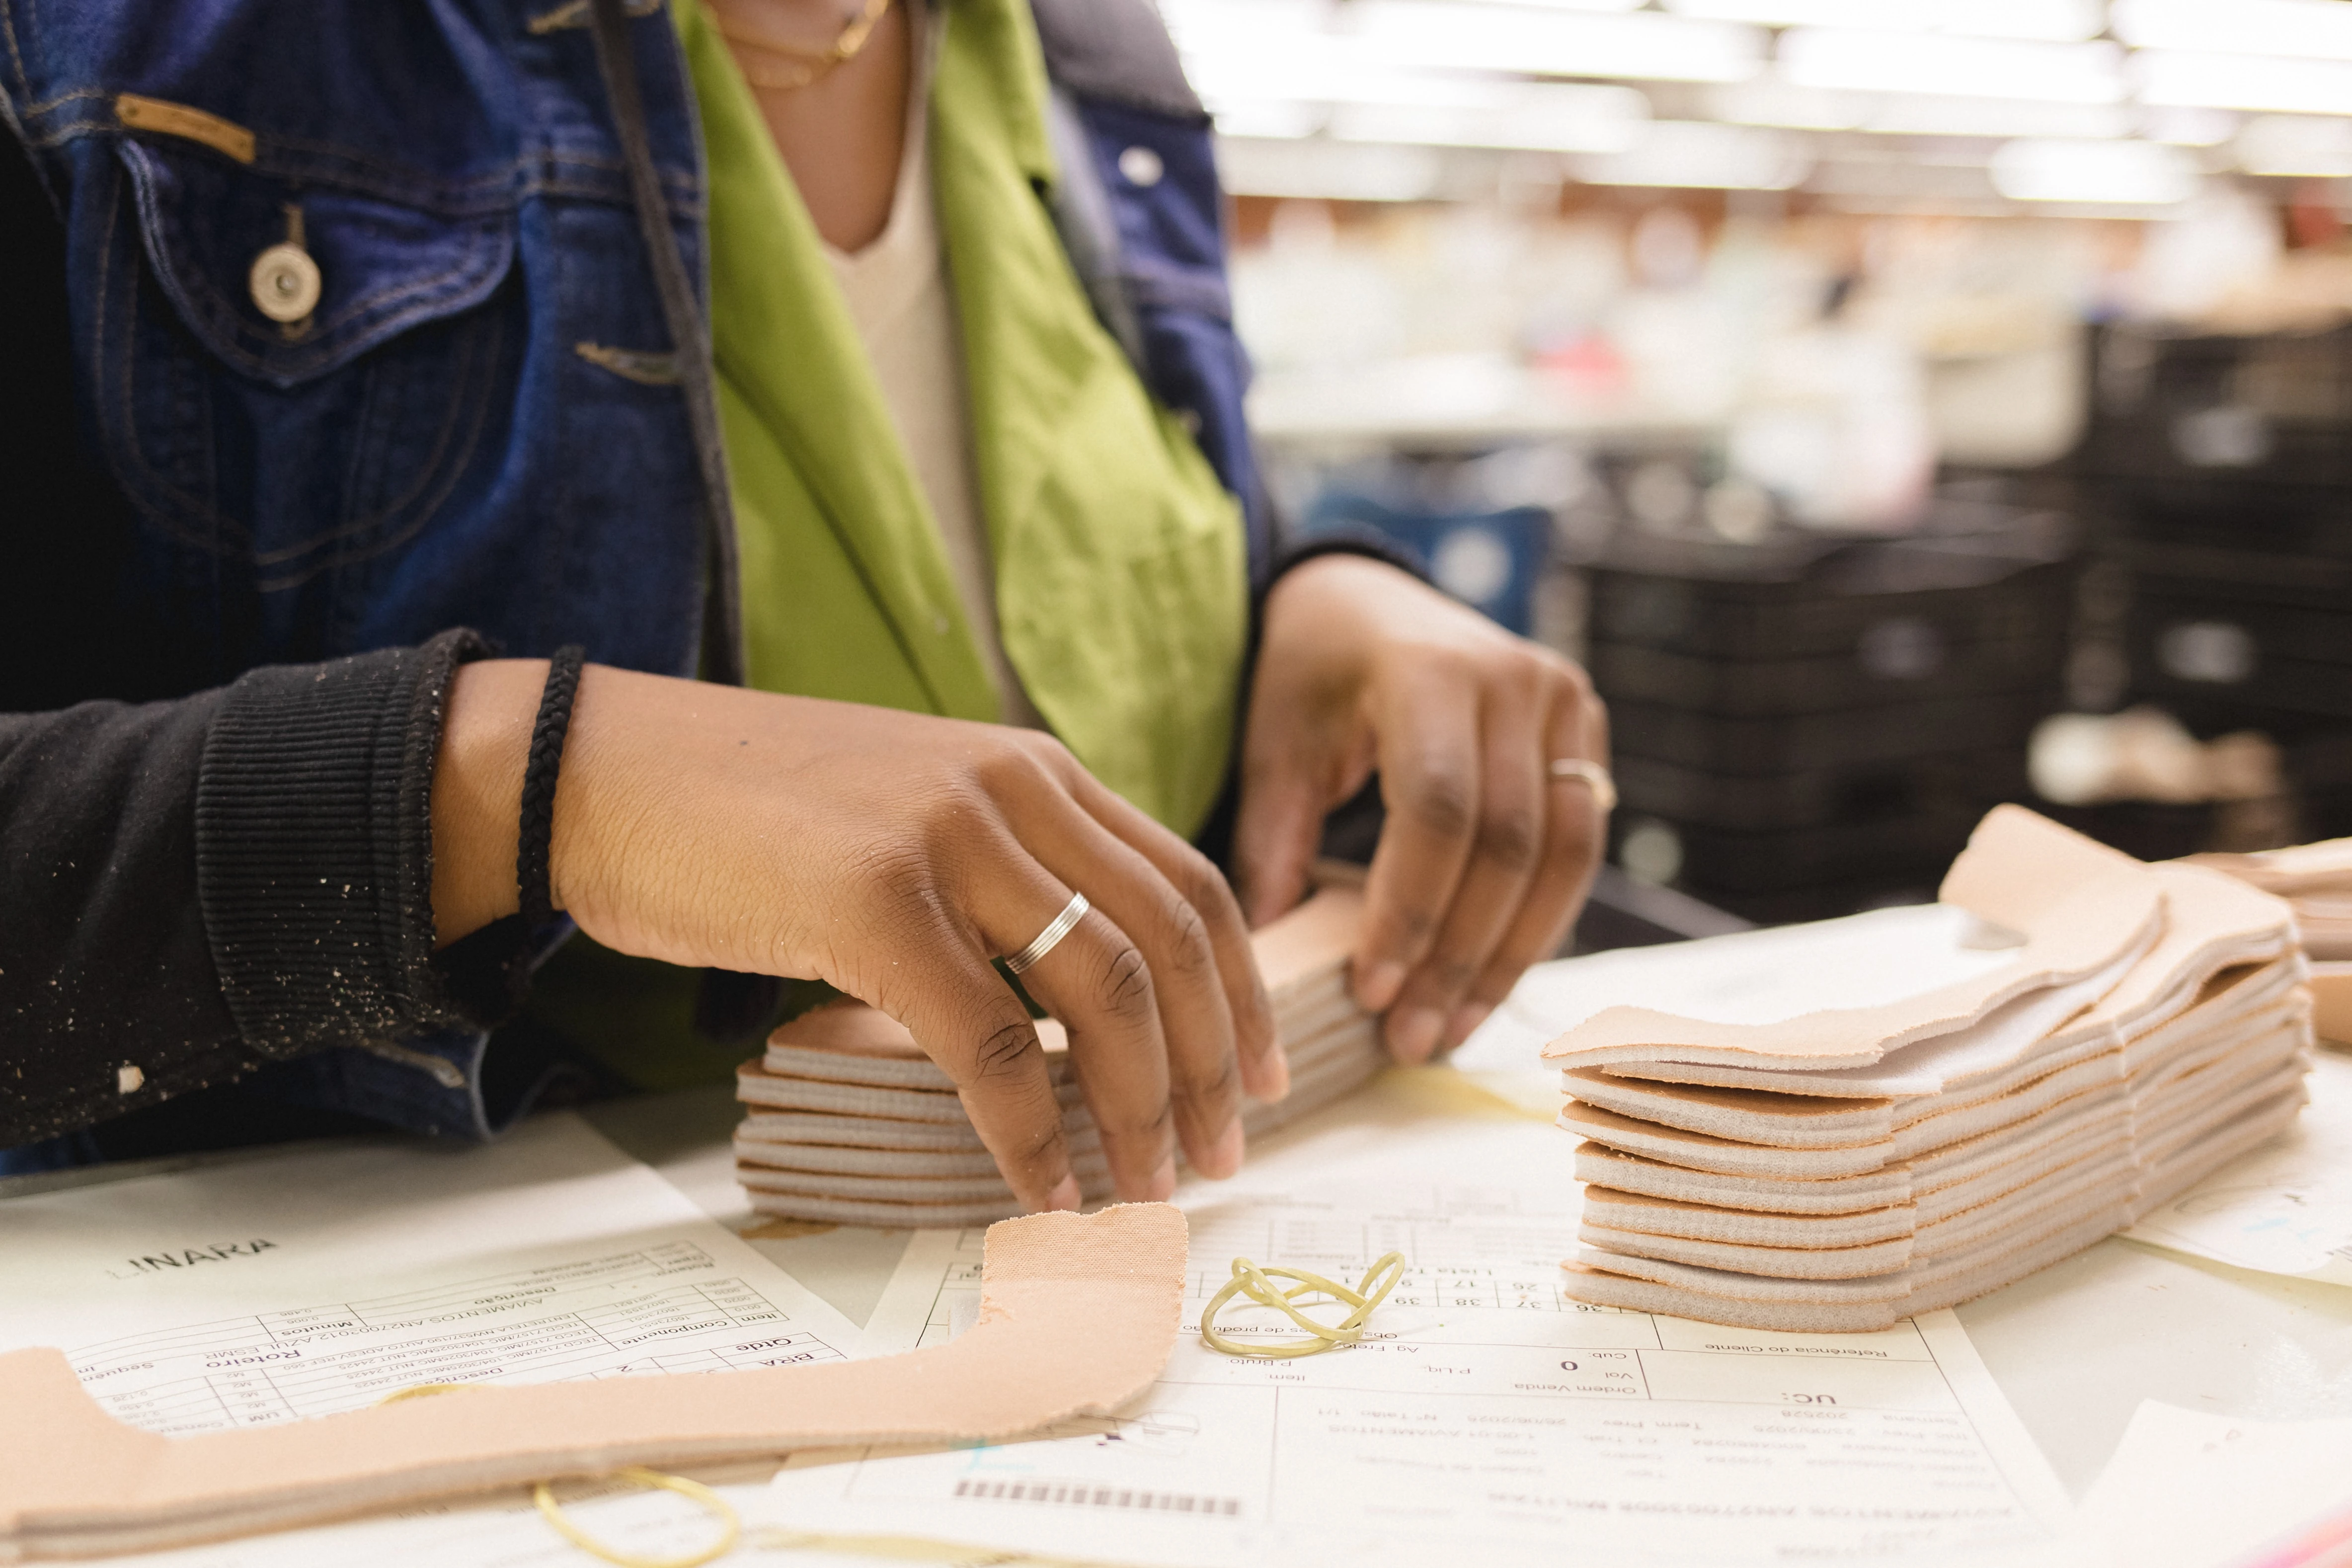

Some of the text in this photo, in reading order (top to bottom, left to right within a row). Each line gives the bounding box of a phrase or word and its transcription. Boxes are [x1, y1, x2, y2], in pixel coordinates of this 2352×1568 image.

[429, 1297, 543, 1324] AVIAMENTOS
[281, 1321, 354, 1336] Minutos
[497, 1314, 571, 1333] ENTRETELA
[622, 1313, 778, 1345] Item Componente
[264, 1336, 312, 1350] AZUL
[388, 1340, 424, 1350] AUTO
[736, 1337, 792, 1351] Qtde
[1704, 1343, 1764, 1352] Cliente
[205, 1346, 260, 1359] ESMR
[340, 1347, 384, 1360] ADESV
[381, 1352, 407, 1362] NUT
[1795, 1346, 1888, 1357] Referência
[206, 1349, 302, 1368] Roteiro
[311, 1356, 336, 1366] REF
[759, 1352, 815, 1366] BRA
[389, 1362, 415, 1372] NUT
[1576, 1385, 1637, 1394] Ordem
[1781, 1392, 1837, 1405] UC:
[249, 1411, 280, 1422] UM
